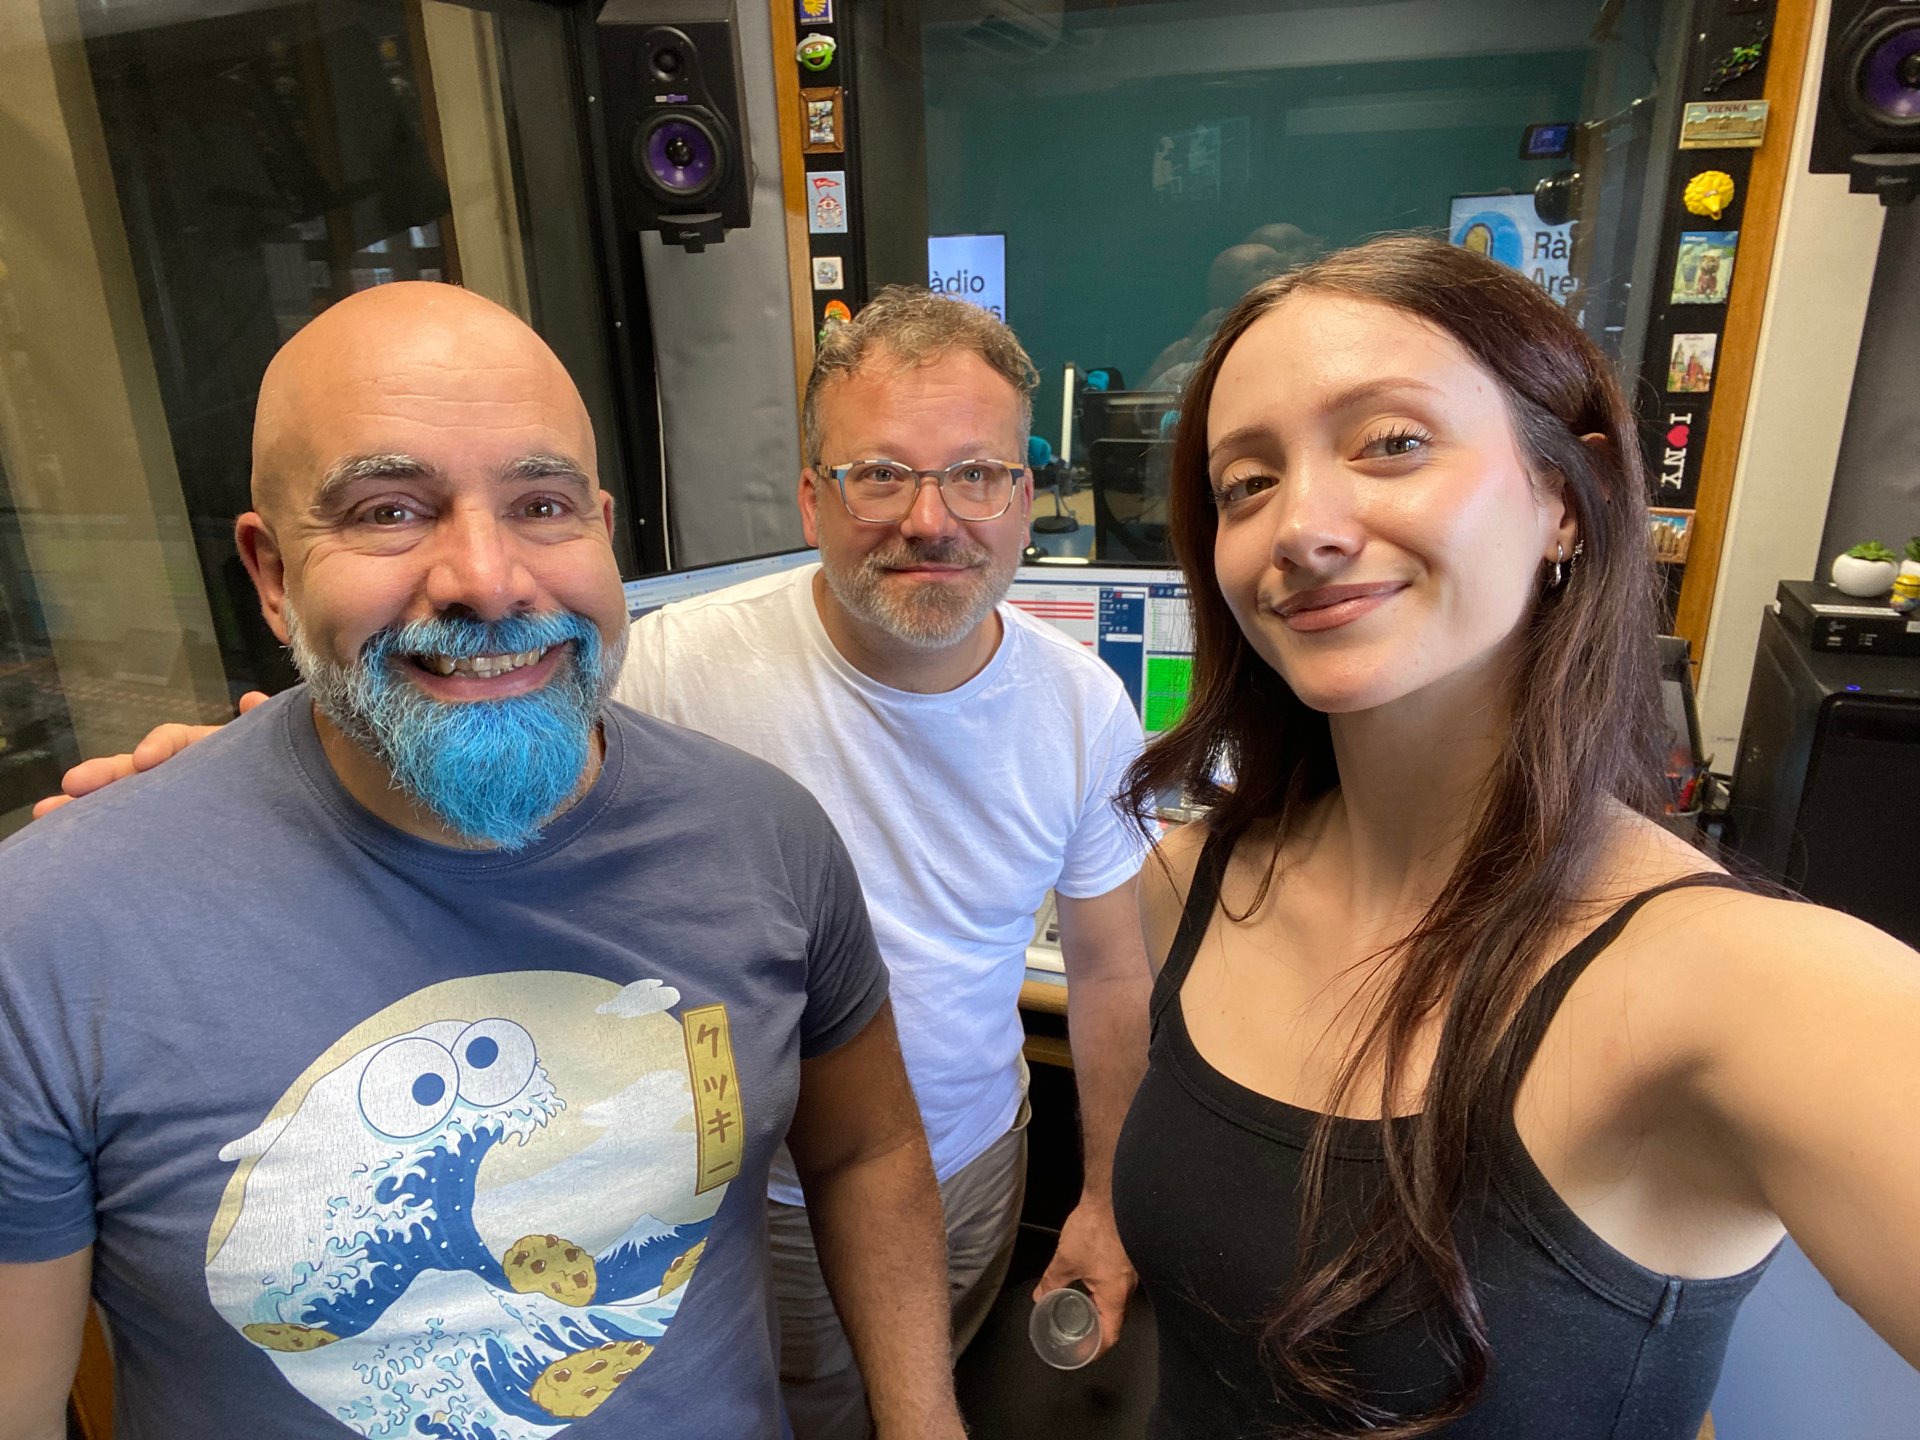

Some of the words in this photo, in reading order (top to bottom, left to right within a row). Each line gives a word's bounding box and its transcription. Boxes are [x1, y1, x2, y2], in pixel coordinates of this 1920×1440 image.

[1706, 103, 1749, 113] VIENNA
[1669, 413, 1692, 425] I
[1661, 447, 1687, 490] NY
